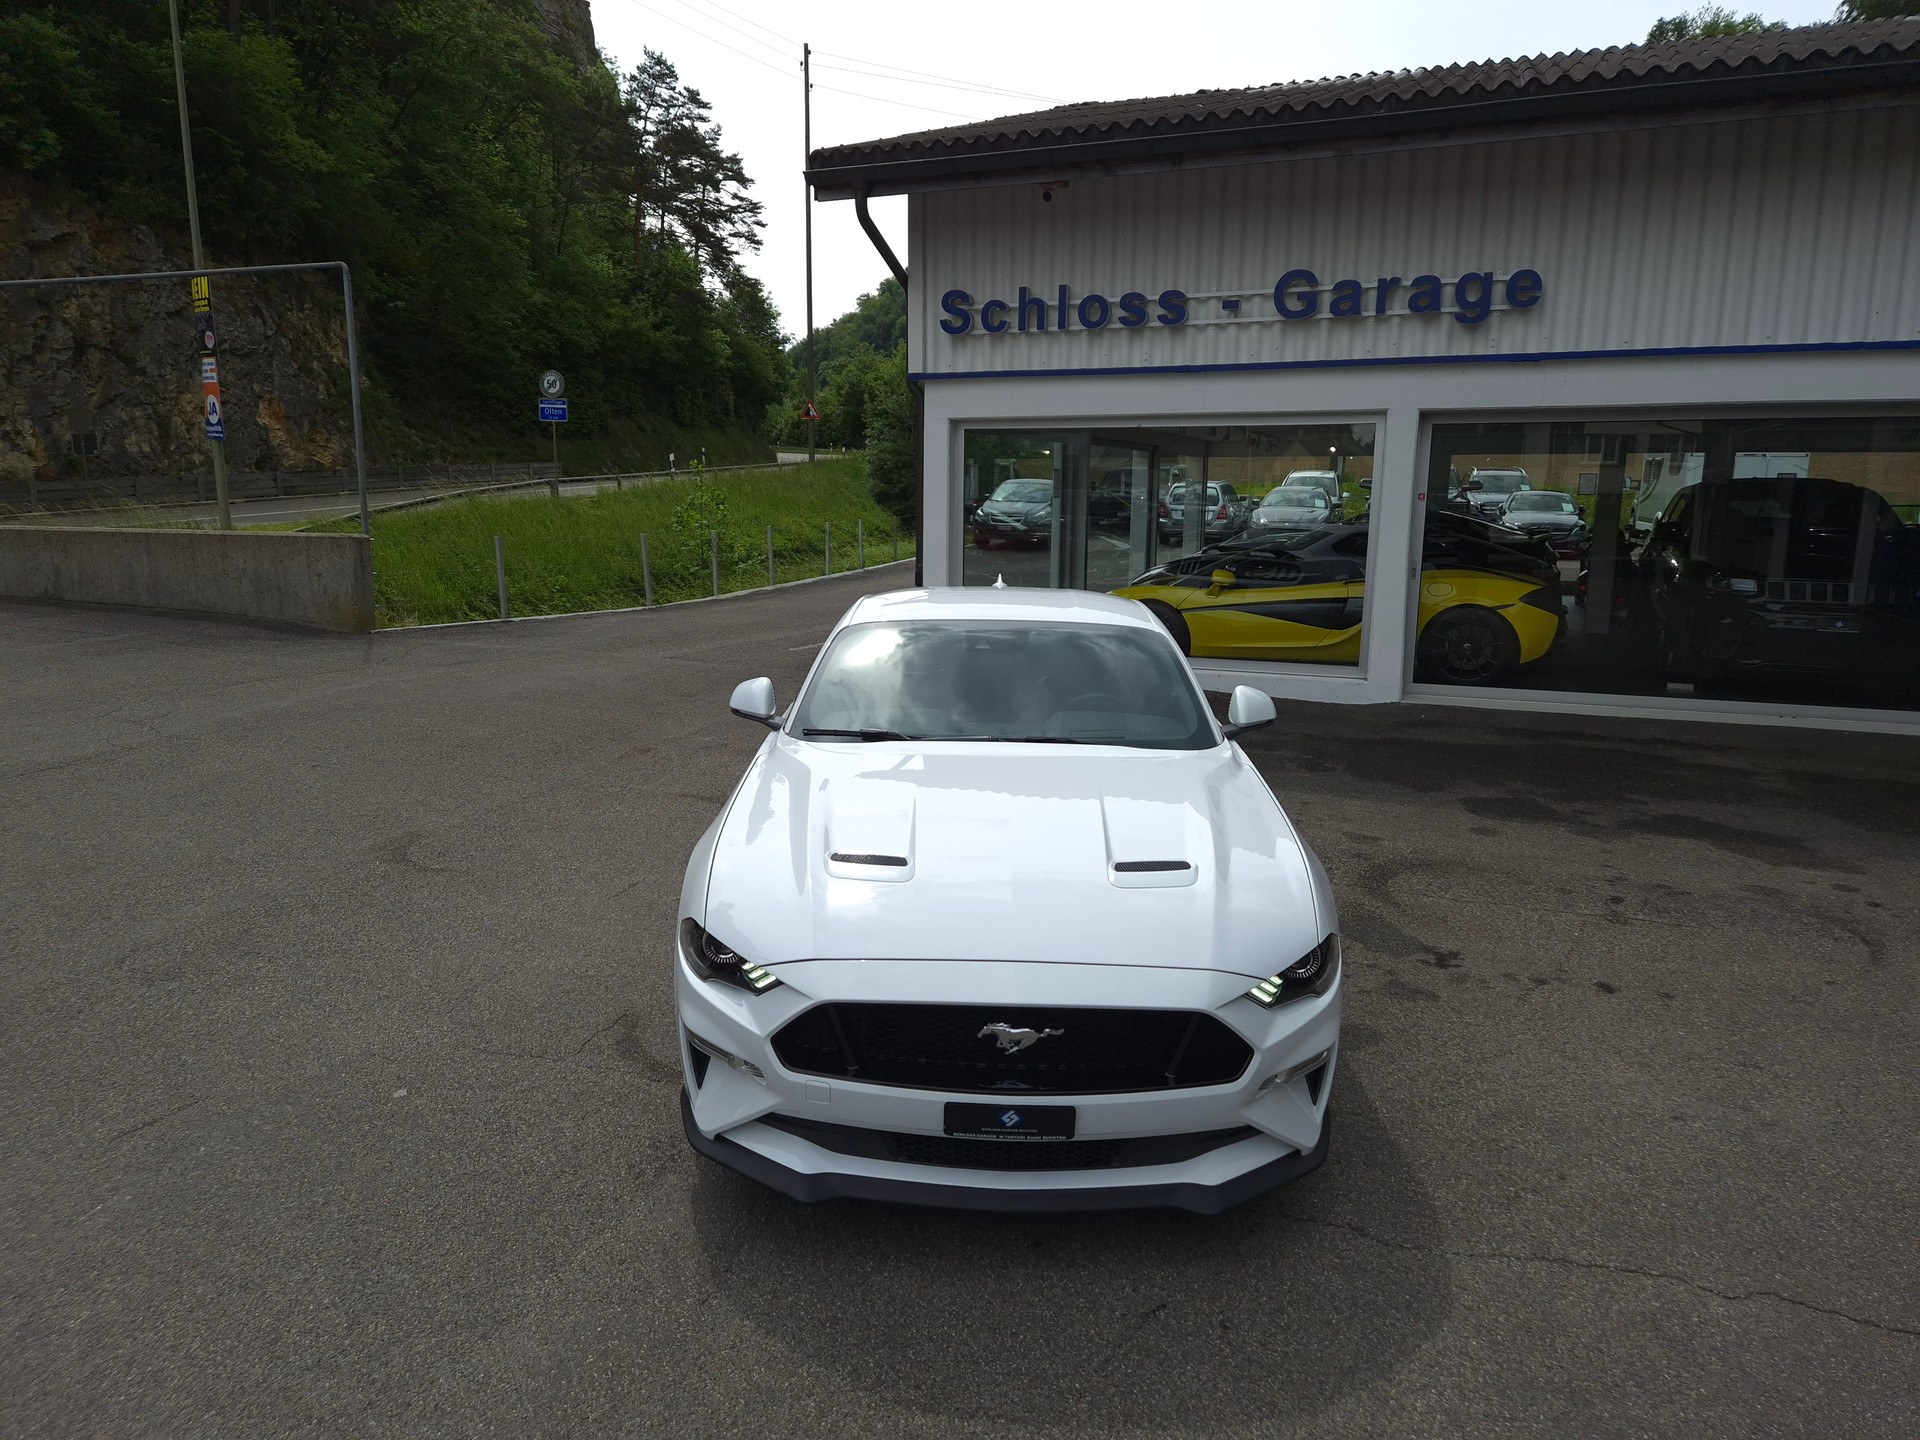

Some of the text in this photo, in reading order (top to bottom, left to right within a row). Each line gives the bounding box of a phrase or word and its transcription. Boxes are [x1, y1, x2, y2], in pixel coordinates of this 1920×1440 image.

[939, 284, 1188, 336] Schloss
[1273, 268, 1543, 325] Garage
[547, 379, 557, 389] 50
[208, 401, 218, 416] JA
[544, 407, 563, 415] Olten
